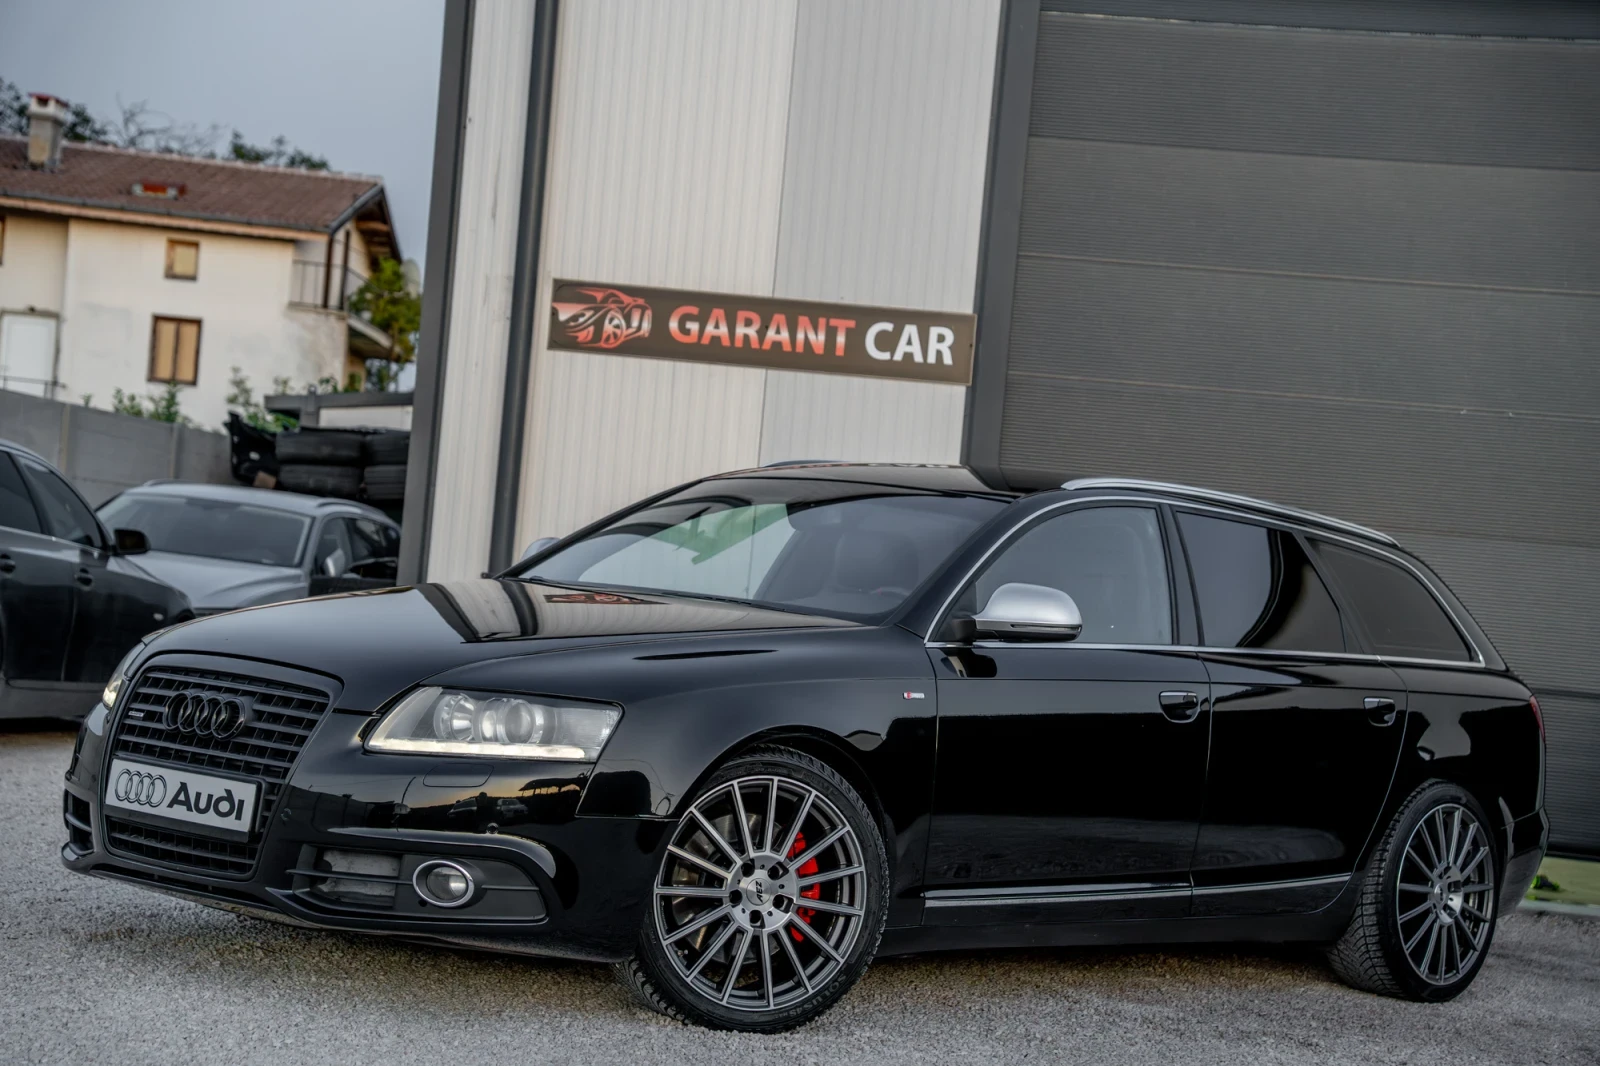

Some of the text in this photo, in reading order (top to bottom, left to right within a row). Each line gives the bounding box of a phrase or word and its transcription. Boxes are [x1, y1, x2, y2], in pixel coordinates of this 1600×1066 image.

[668, 305, 956, 366] GARANT CAR
[166, 781, 246, 821] Audi
[755, 880, 764, 904] AEZ
[803, 973, 846, 1009] SOLUS
